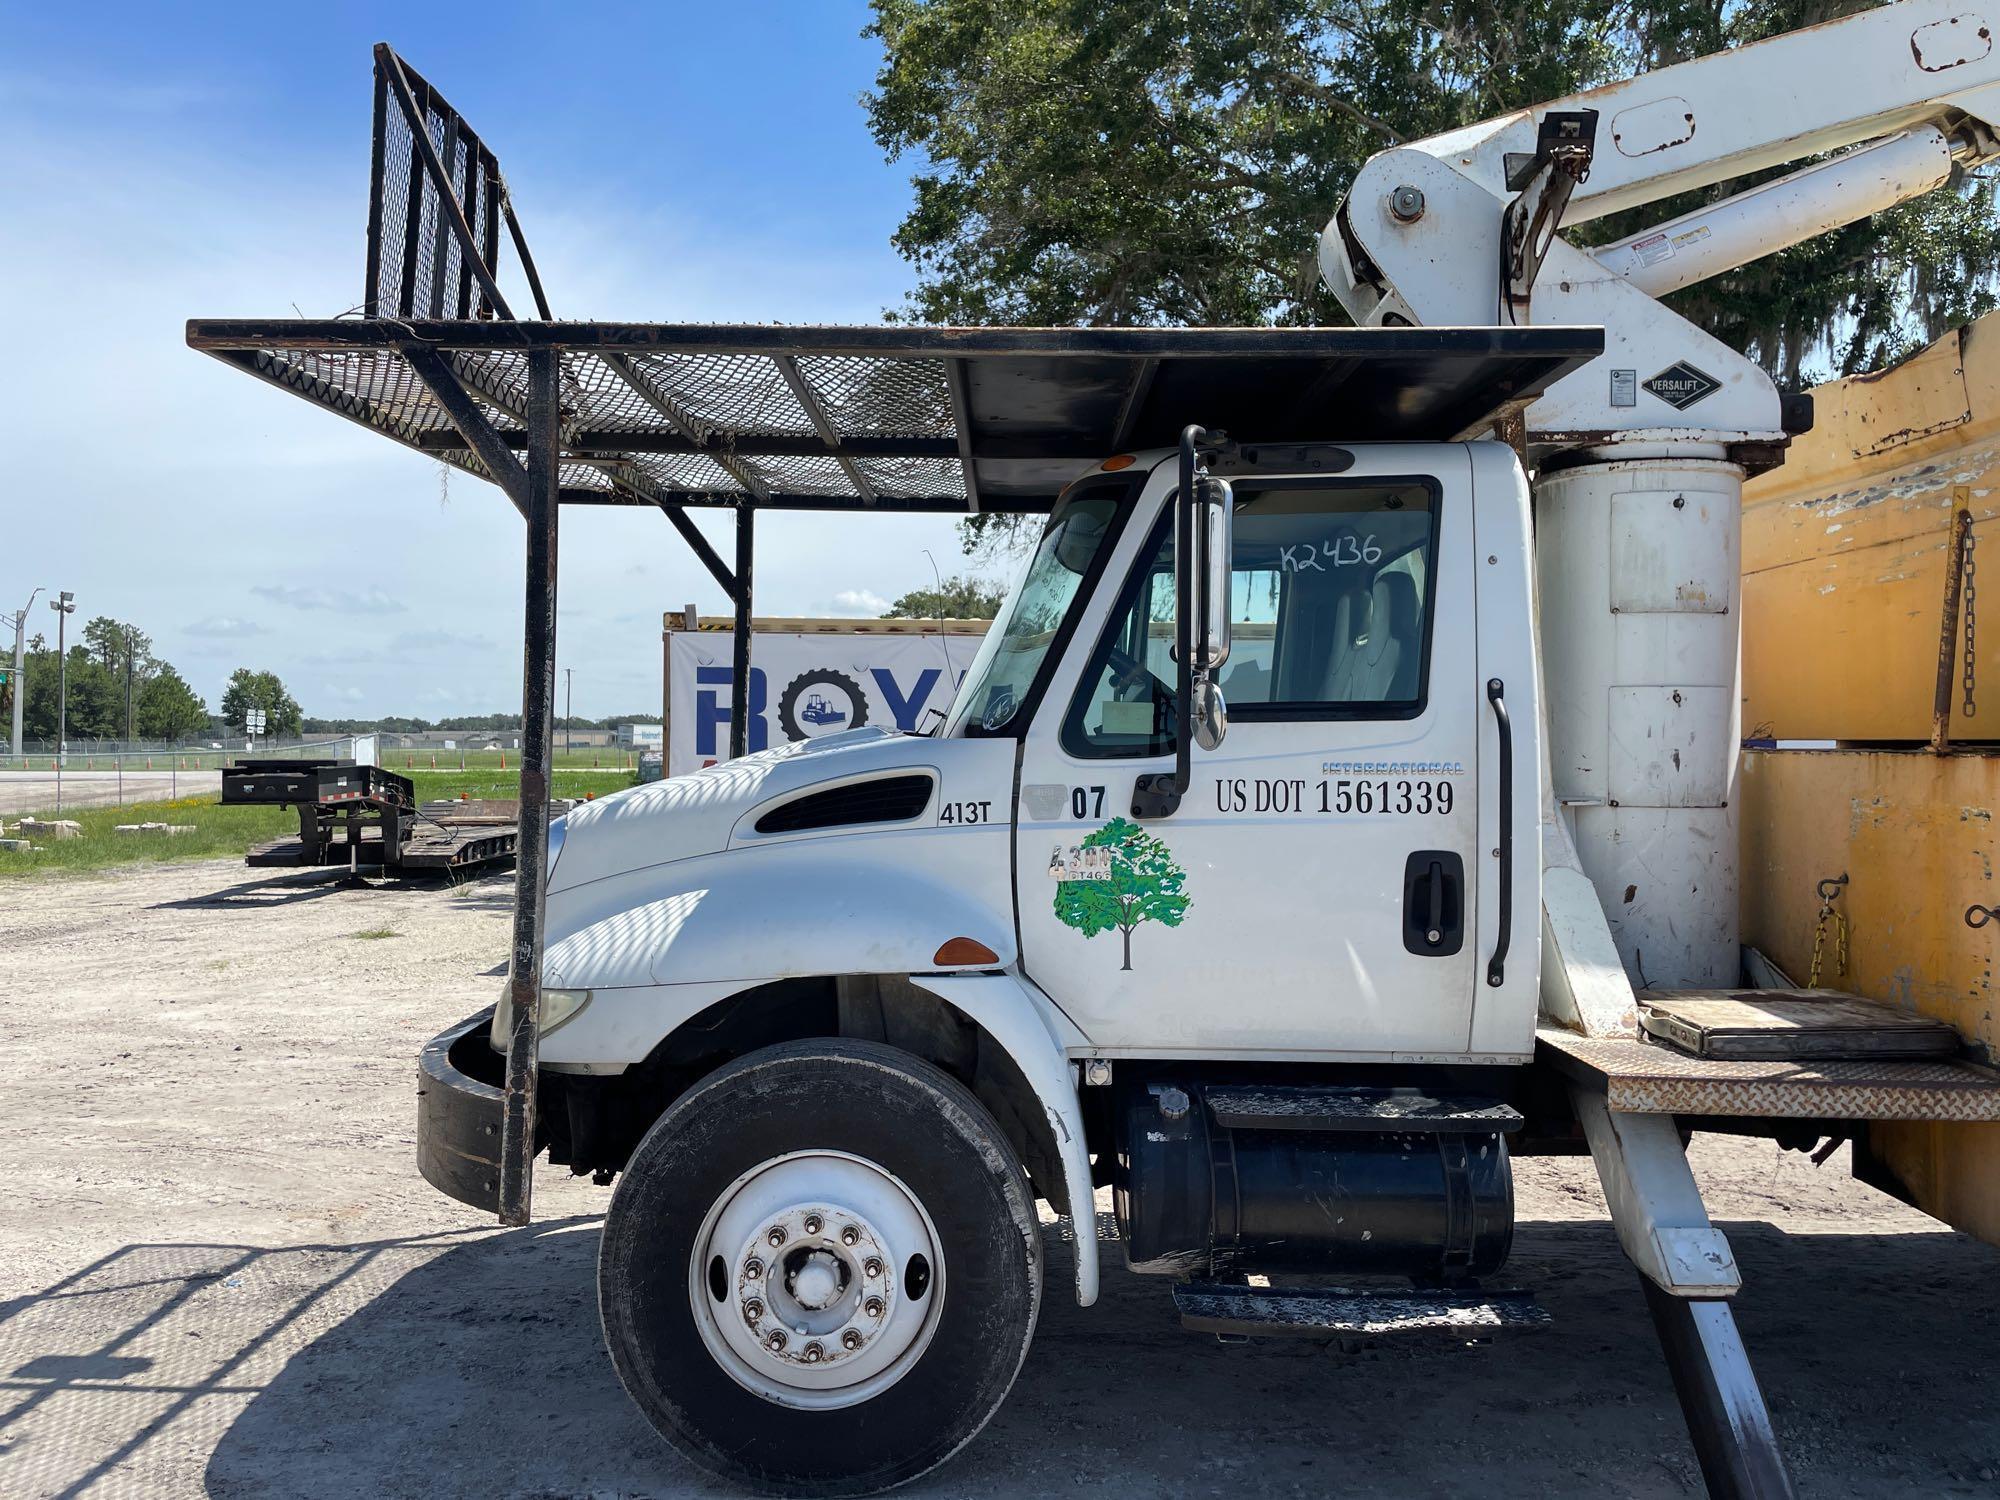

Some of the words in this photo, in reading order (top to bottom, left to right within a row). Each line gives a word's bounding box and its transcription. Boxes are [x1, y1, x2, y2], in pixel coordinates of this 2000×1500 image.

[1651, 380, 1698, 391] VERSALIFT
[1280, 534, 1382, 573] K2436
[1322, 762, 1465, 775] INTERNATIONAL
[1072, 786, 1106, 819] 07
[1216, 779, 1247, 812] US
[1254, 779, 1306, 812] DOT
[1316, 780, 1454, 815] 1561339
[940, 801, 991, 824] 413T
